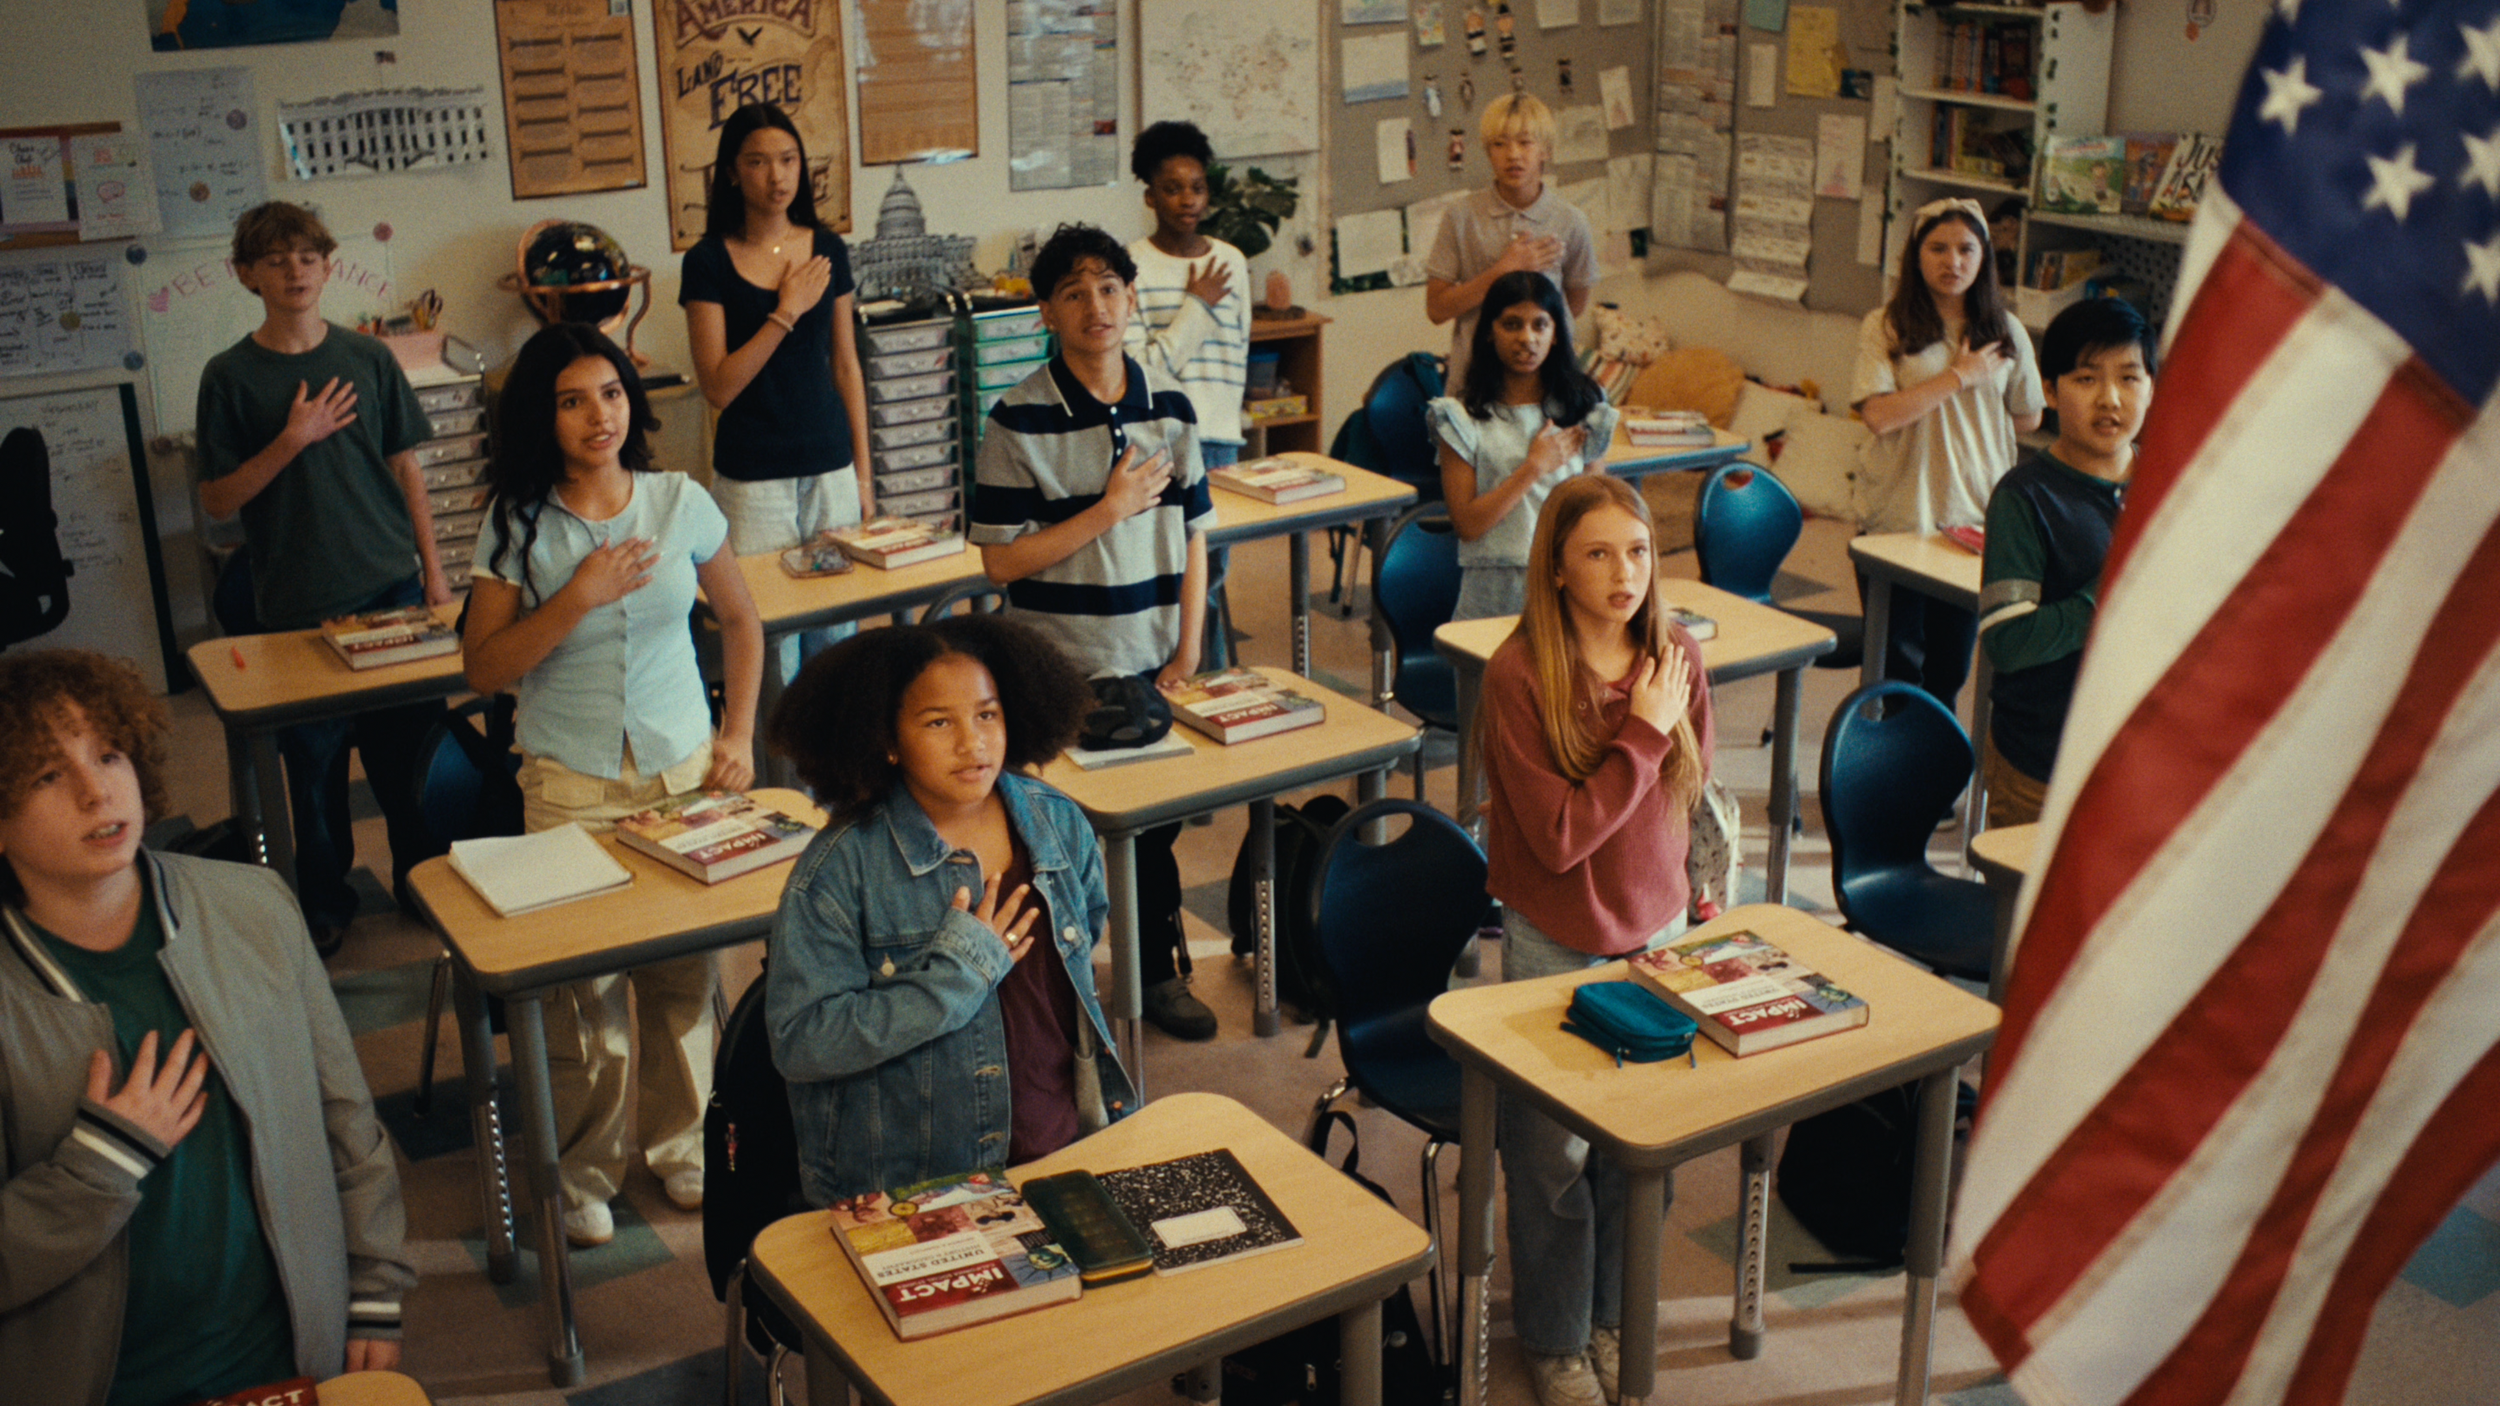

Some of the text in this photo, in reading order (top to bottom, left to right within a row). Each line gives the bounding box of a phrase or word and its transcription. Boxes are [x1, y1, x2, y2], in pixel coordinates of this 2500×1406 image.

[676, 51, 723, 99] LAND
[708, 64, 802, 131] FREE
[172, 264, 215, 296] BE
[1729, 1000, 1808, 1026] IMPACT
[877, 1249, 985, 1278] UNITED STATES
[900, 1267, 1004, 1302] IMPACT
